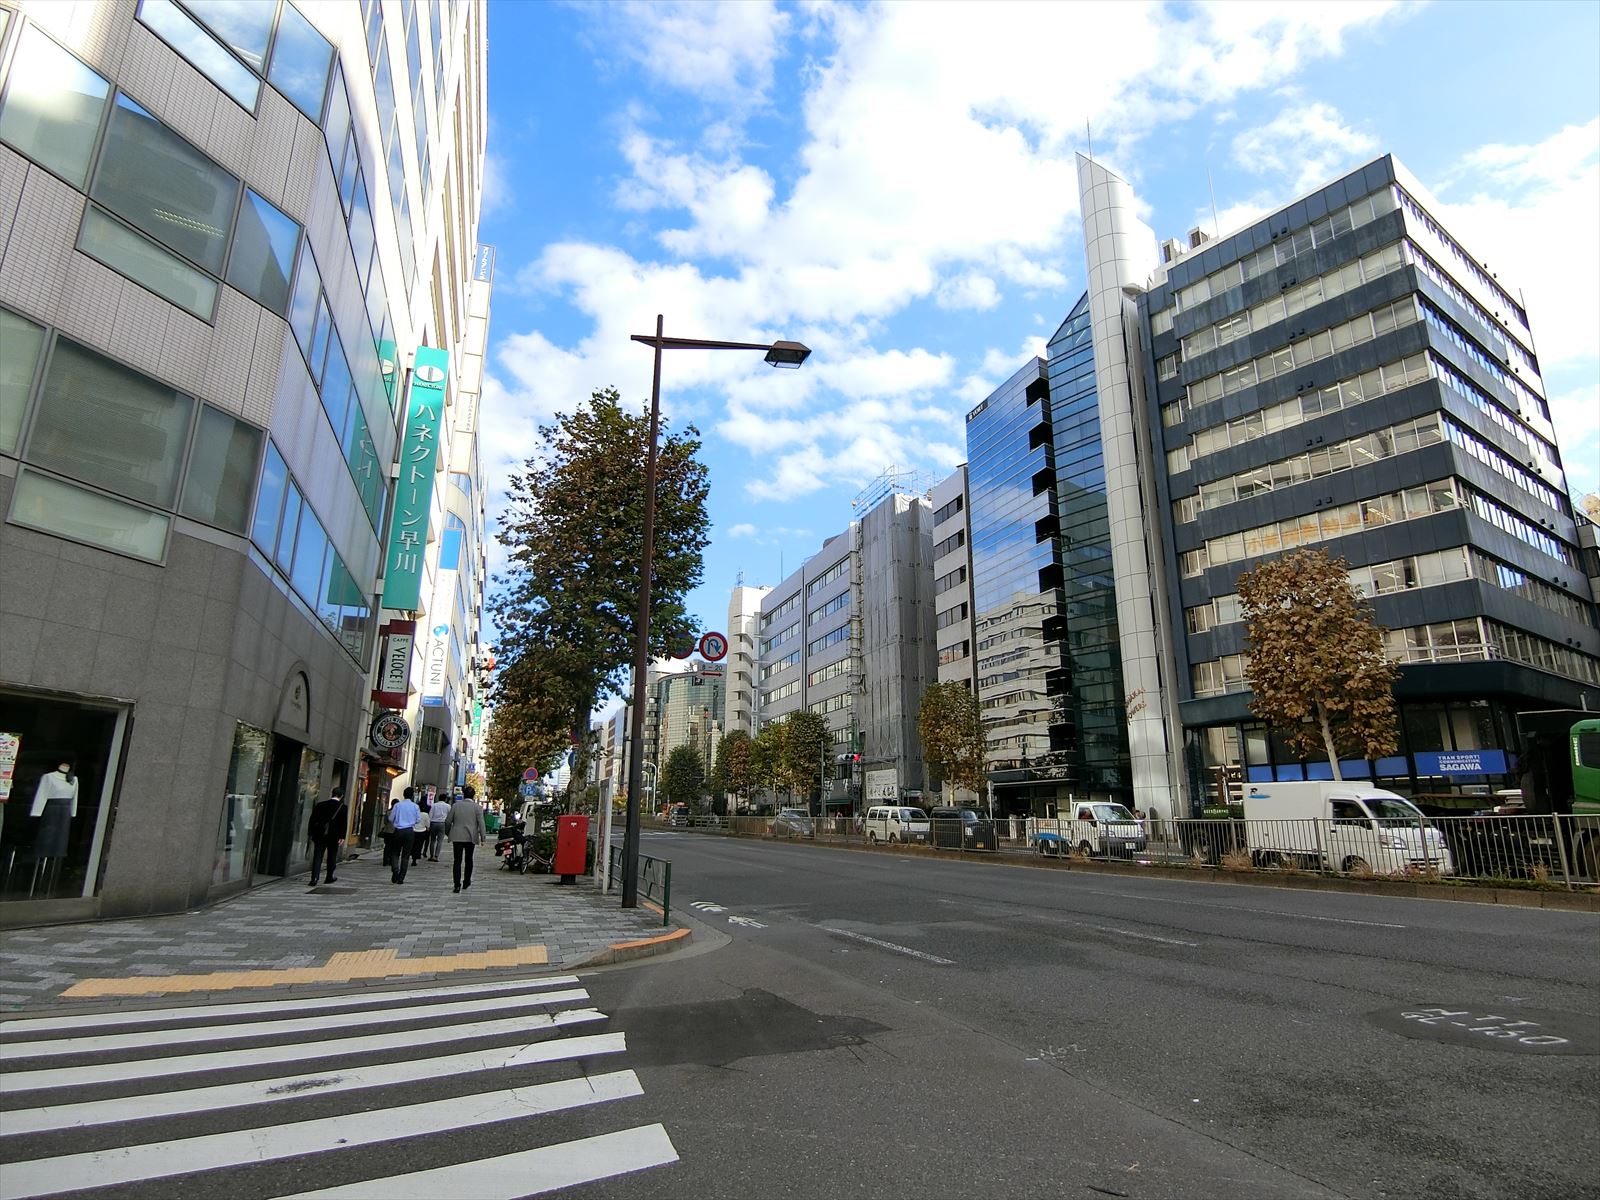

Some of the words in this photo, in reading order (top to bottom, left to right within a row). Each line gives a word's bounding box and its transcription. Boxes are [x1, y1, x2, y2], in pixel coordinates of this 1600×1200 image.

[393, 403, 437, 575] ハネクトーン早川
[389, 646, 407, 680] VELOCE
[429, 638, 445, 685] ACTUNI
[1439, 763, 1482, 772] SAGAWA
